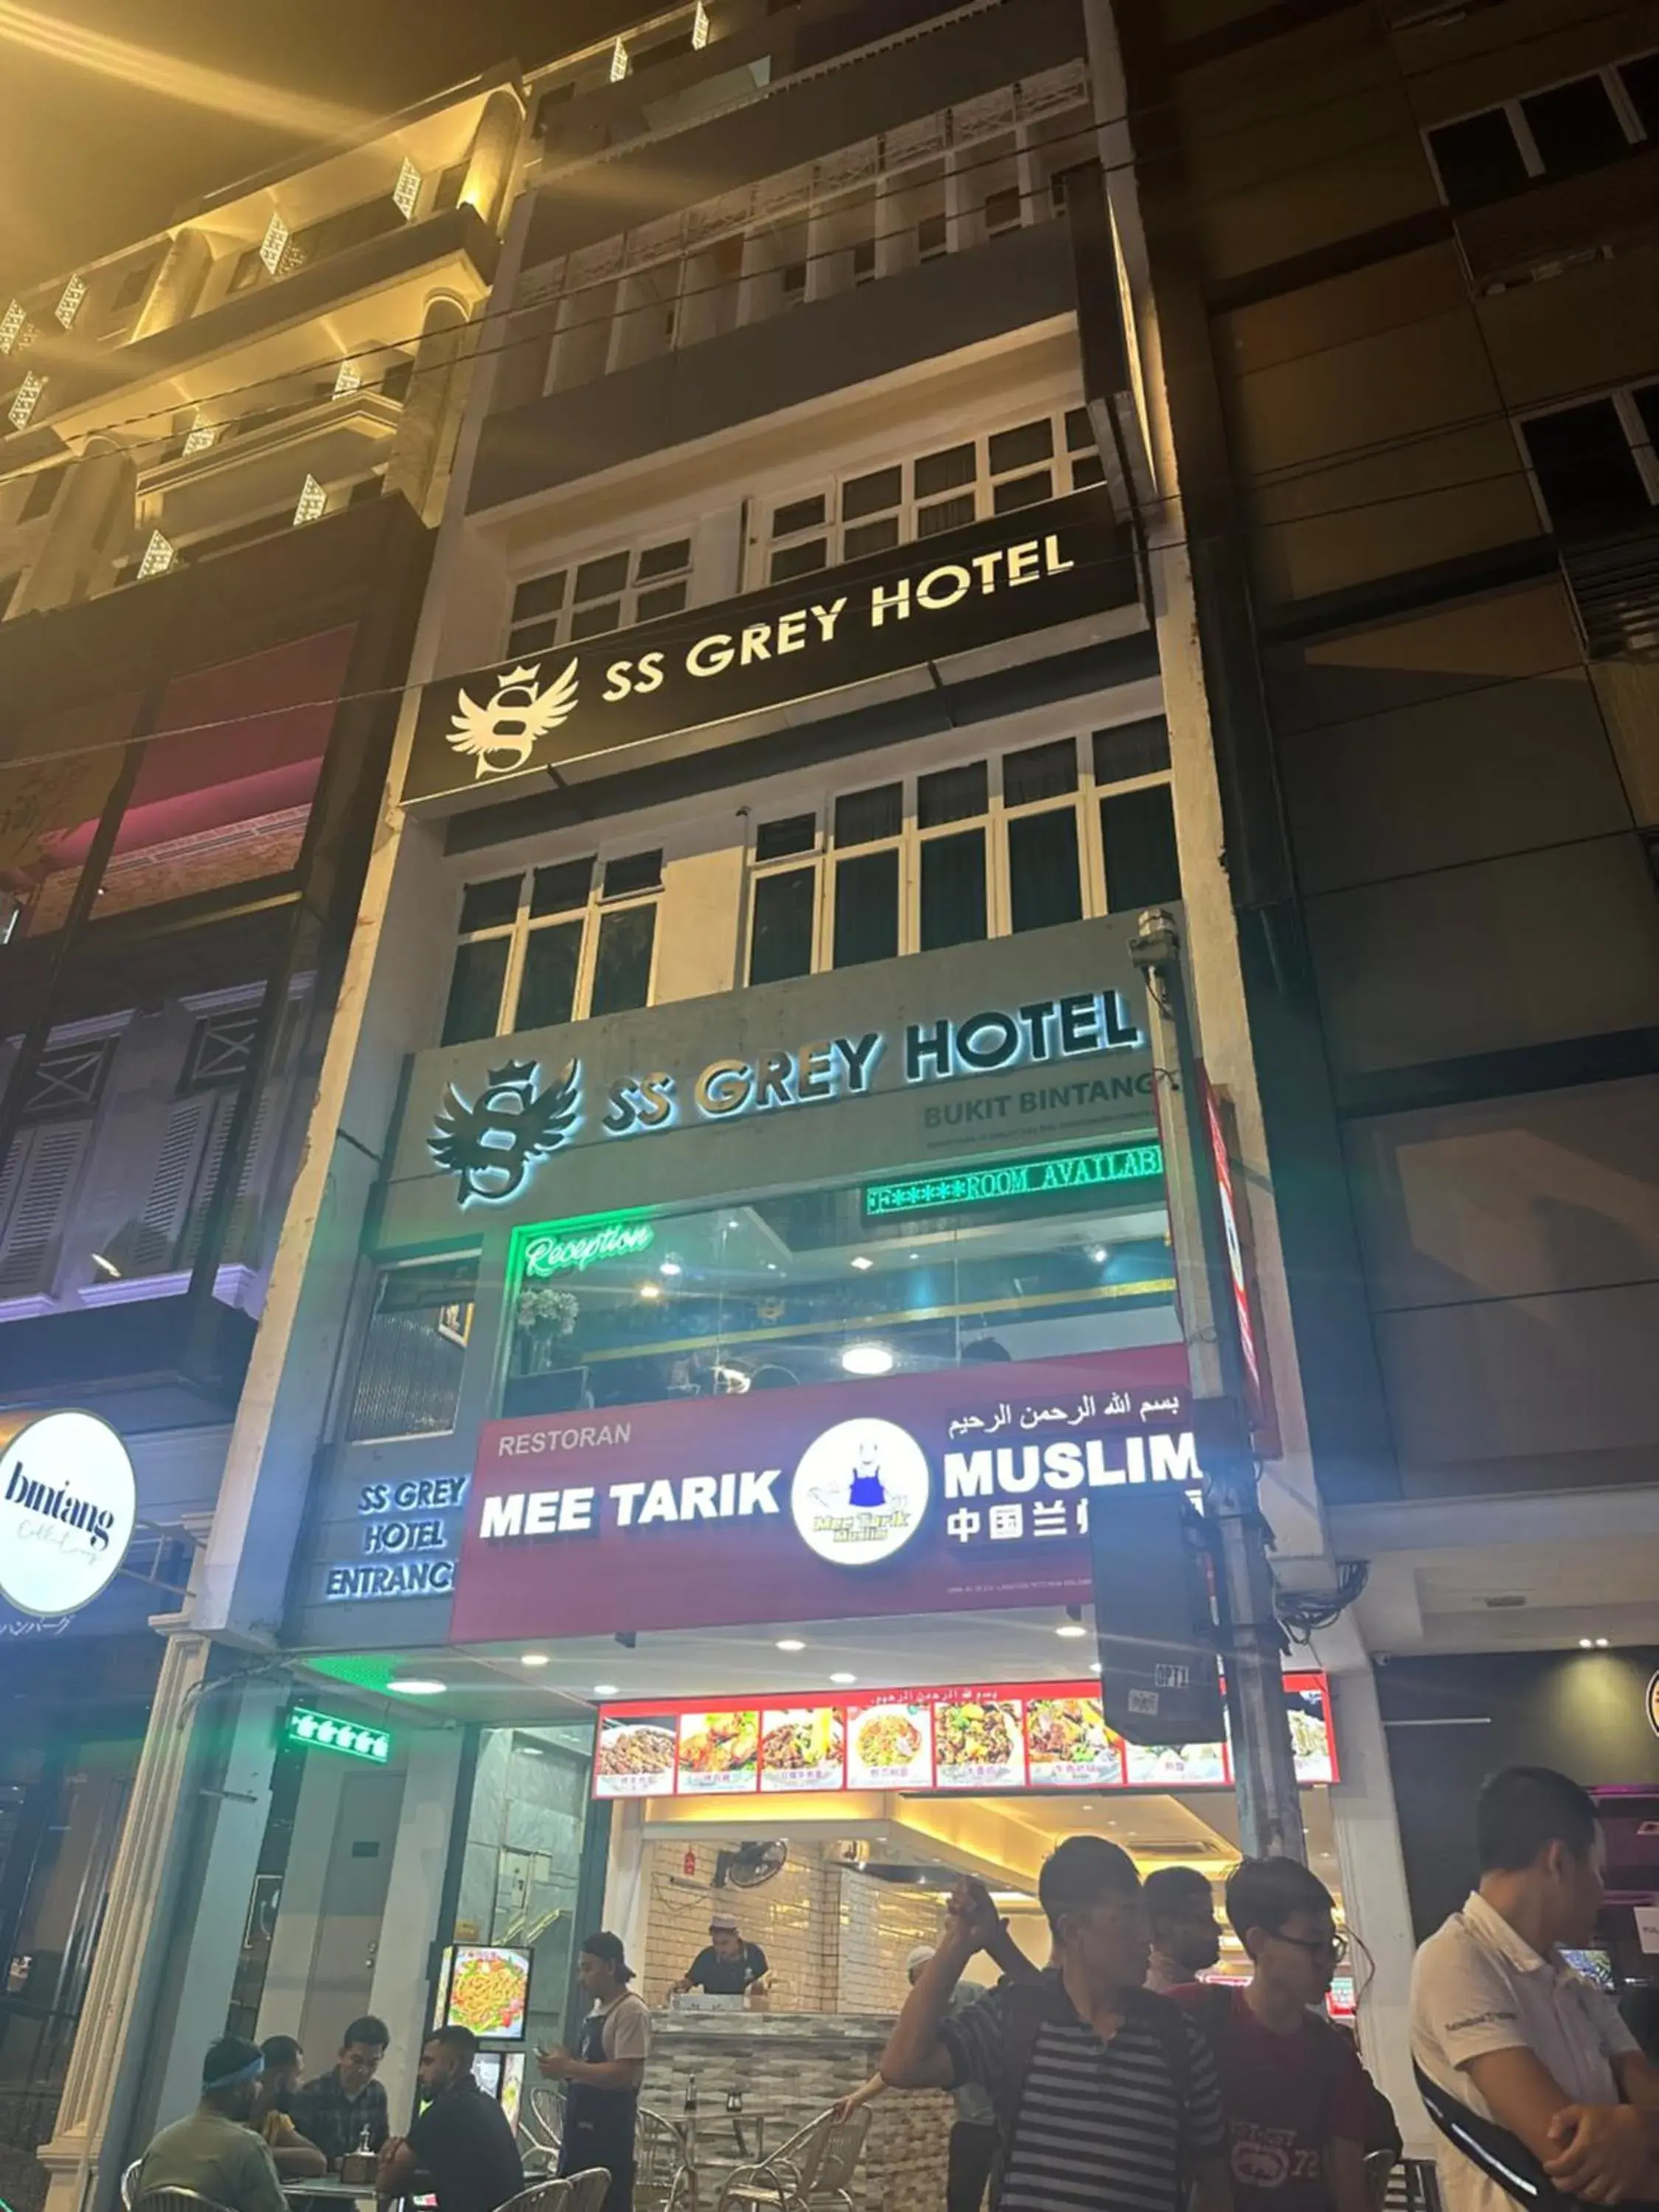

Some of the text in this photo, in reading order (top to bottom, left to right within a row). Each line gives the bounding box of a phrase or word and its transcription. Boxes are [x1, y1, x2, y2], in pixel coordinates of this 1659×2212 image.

[602, 534, 1075, 703] SS GREY HOTEL
[601, 989, 1141, 1137] SS GREY HOTEL
[923, 1071, 1155, 1129] BUKIT BINTANG
[526, 1224, 654, 1277] Reception
[498, 1422, 631, 1457] RESTORAN
[948, 1392, 1180, 1440] بسم الله الرحمن الرحيم
[944, 1432, 1203, 1498] MUSLIM
[4, 1460, 114, 1551] bintang
[358, 1474, 471, 1515] SS GREY
[479, 1470, 782, 1539] MEE TARIK
[364, 1519, 448, 1555] HOTEL
[325, 1558, 458, 1600] ENTRANC
